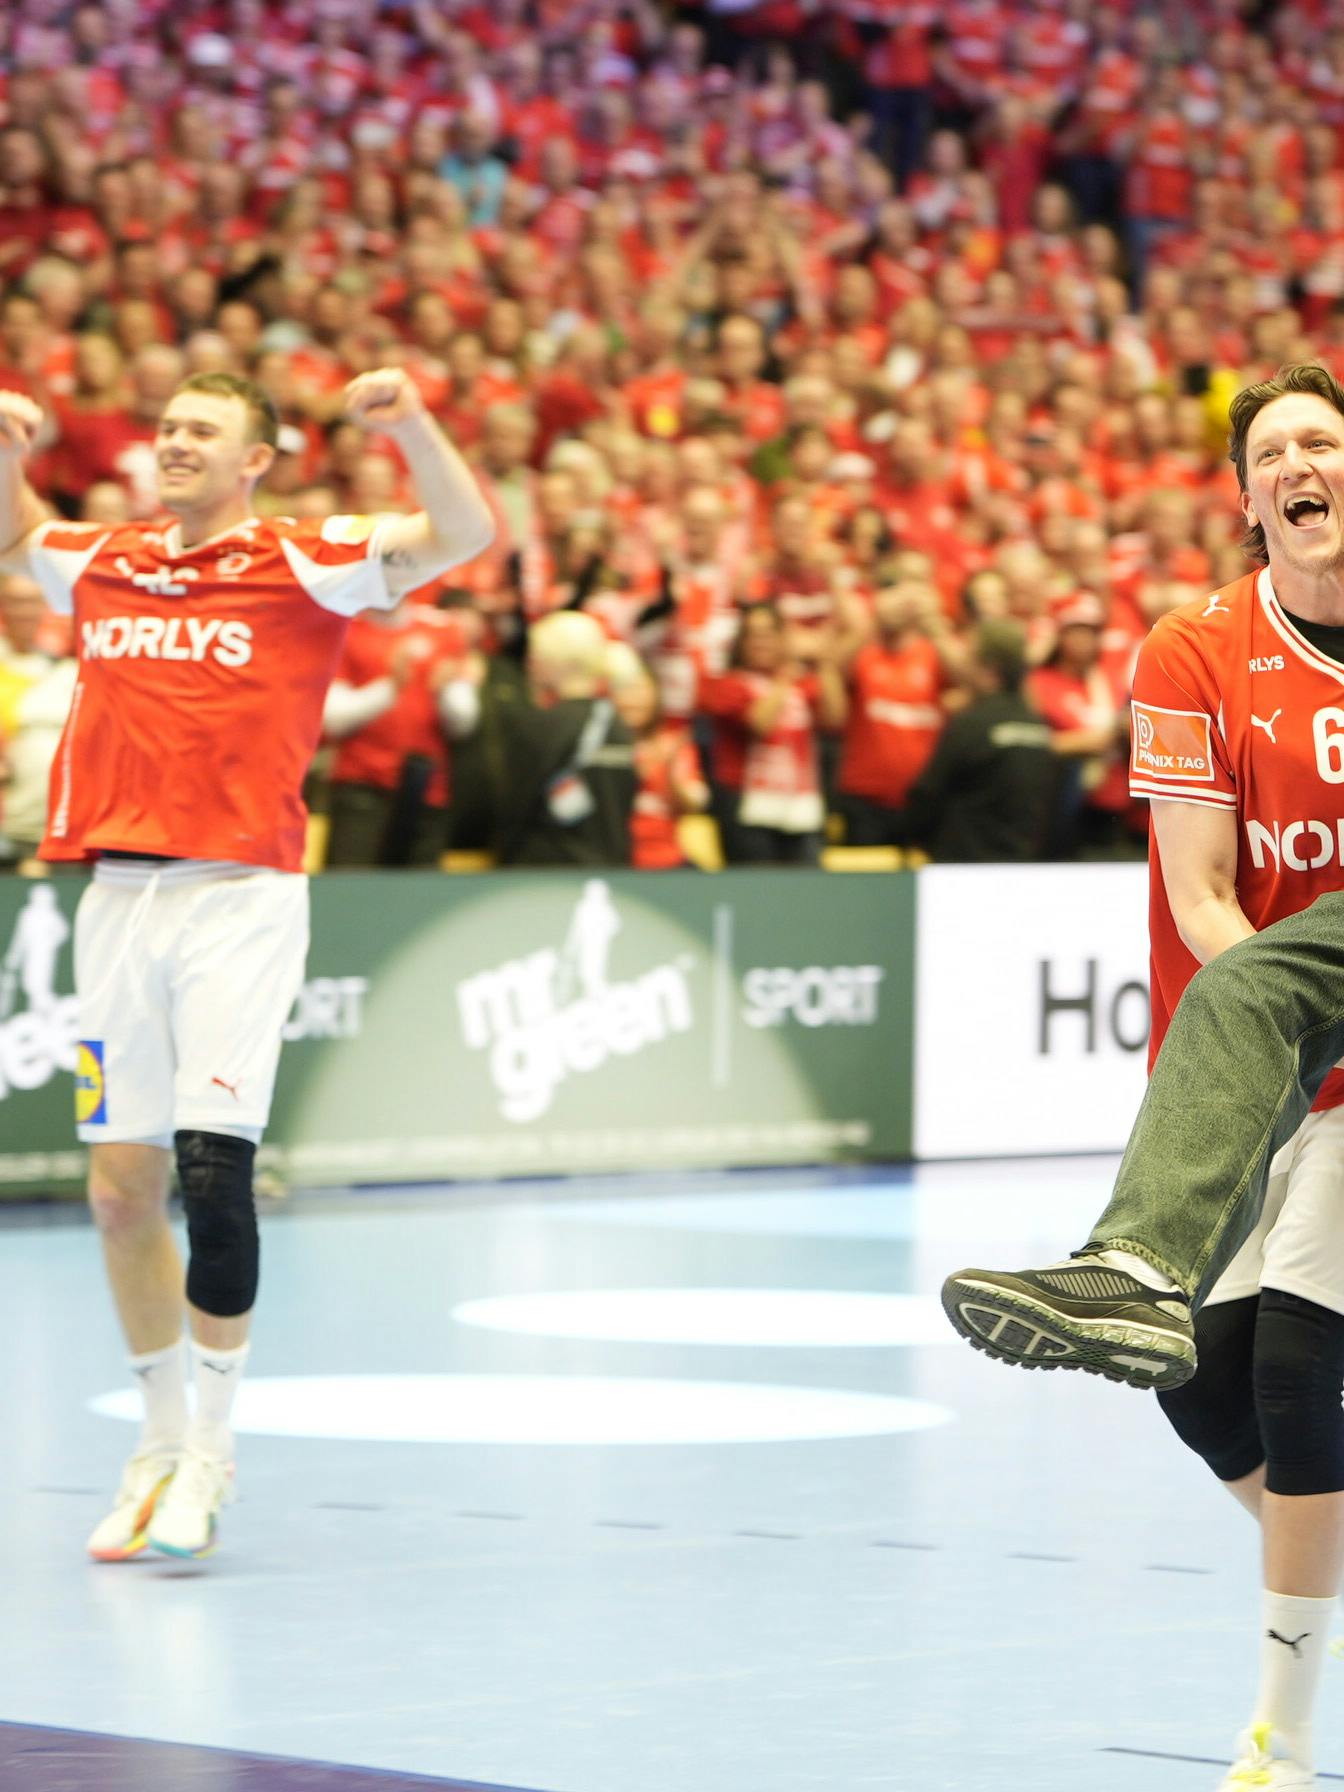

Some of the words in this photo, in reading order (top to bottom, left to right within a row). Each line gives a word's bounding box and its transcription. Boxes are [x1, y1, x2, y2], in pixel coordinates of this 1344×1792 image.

[81, 616, 254, 667] NORLYS
[1248, 654, 1286, 675] RLYS
[1176, 756, 1206, 770] TAG
[742, 965, 886, 1029] SPORT
